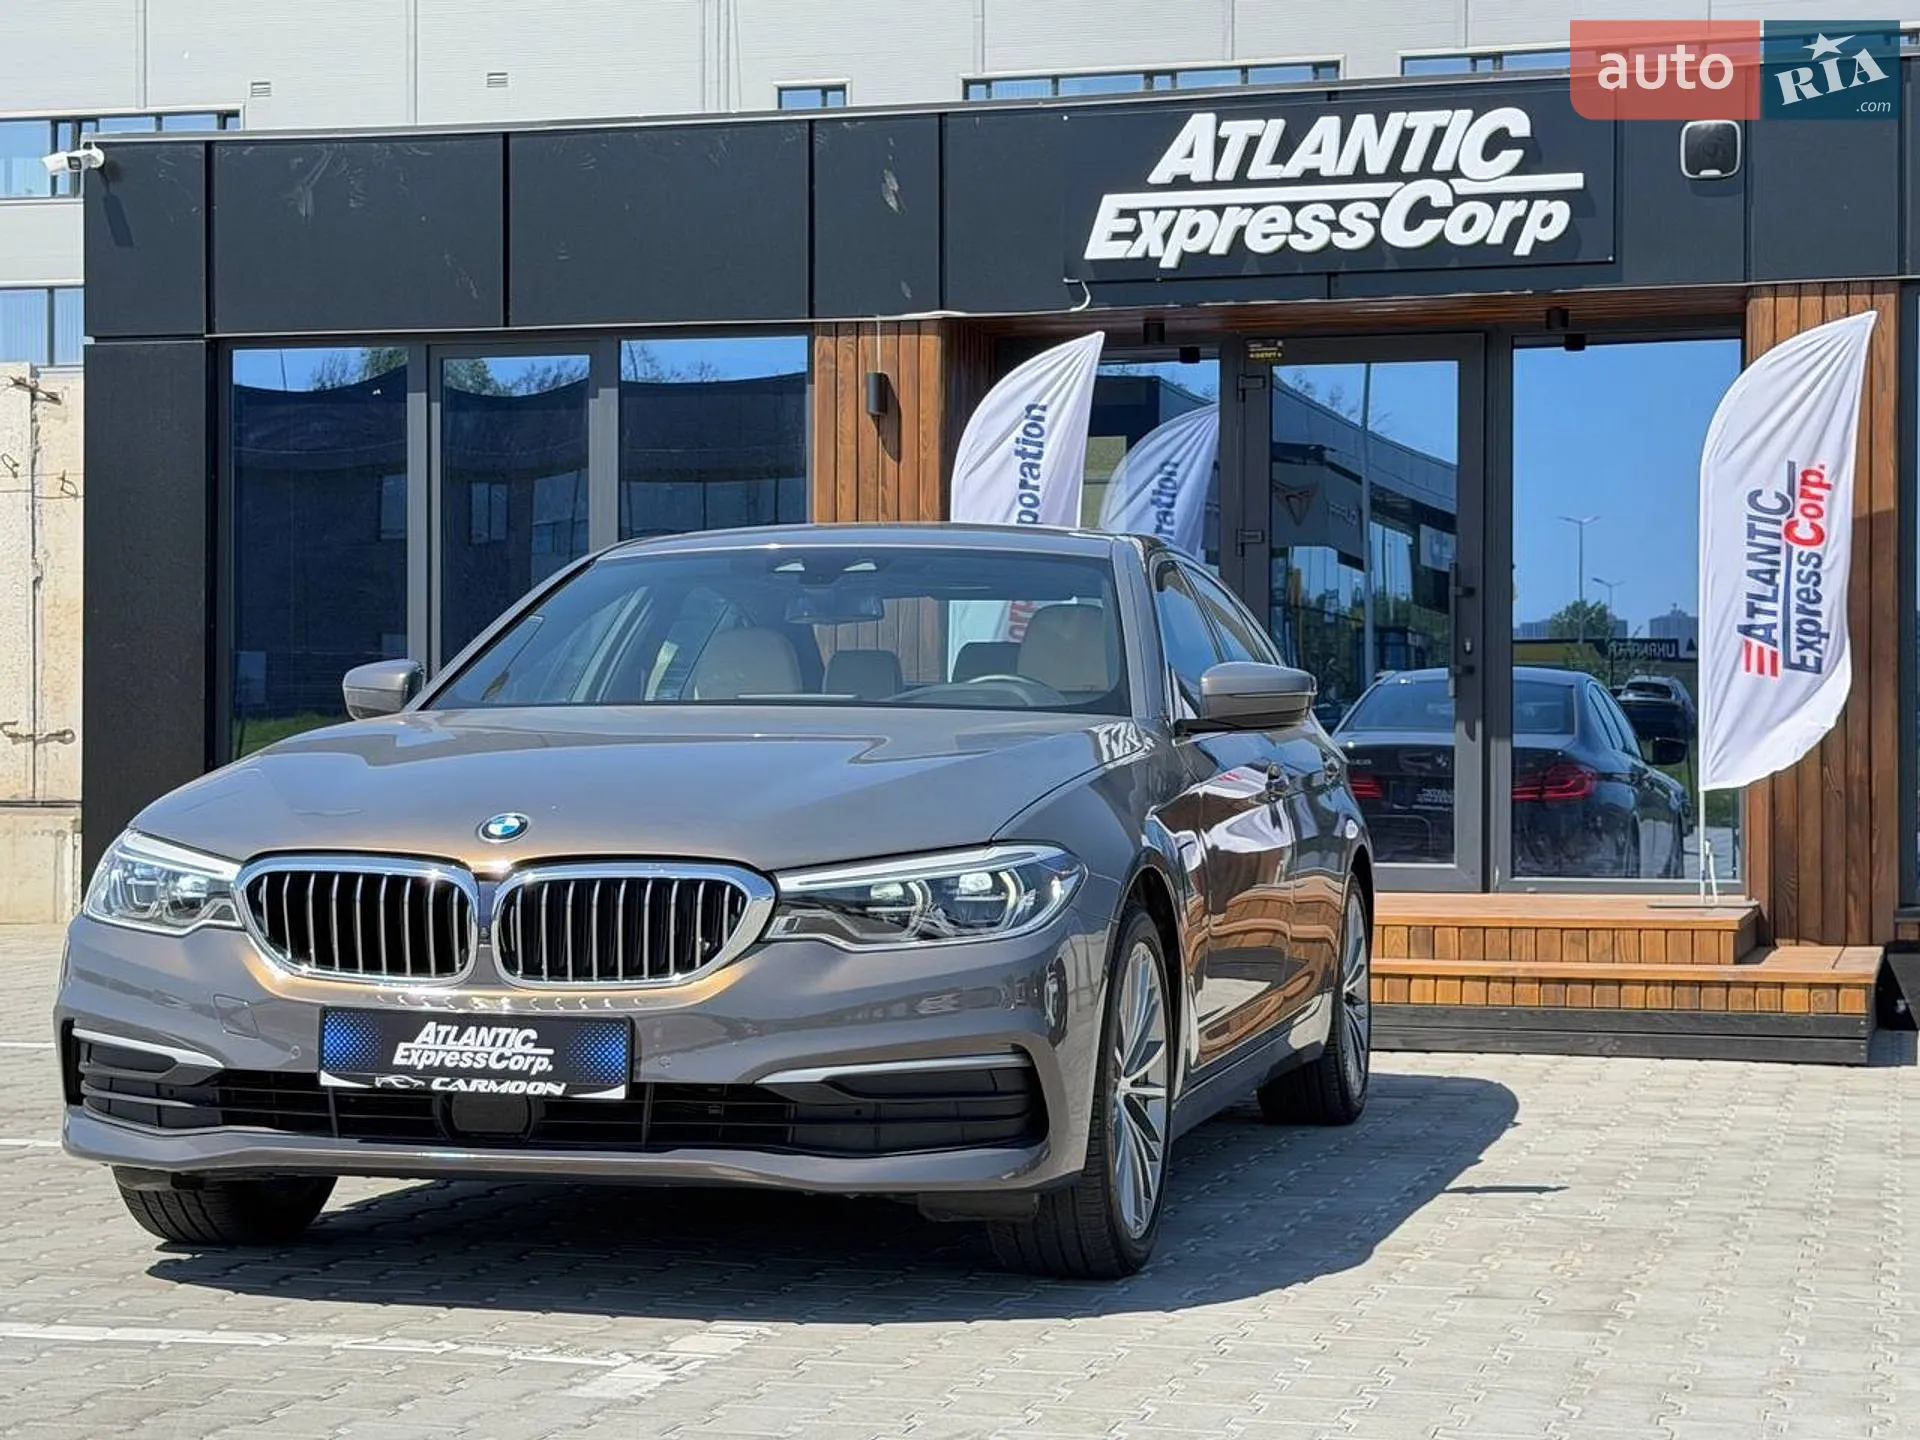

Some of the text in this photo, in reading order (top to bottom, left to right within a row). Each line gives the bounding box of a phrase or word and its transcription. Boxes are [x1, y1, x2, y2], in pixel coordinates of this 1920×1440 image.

[1147, 107, 1532, 184] ATLANTIC
[1737, 488, 1792, 649] ATLANTIC
[413, 1021, 538, 1050] ATLANTIC
[431, 1077, 567, 1096] CARMOON
